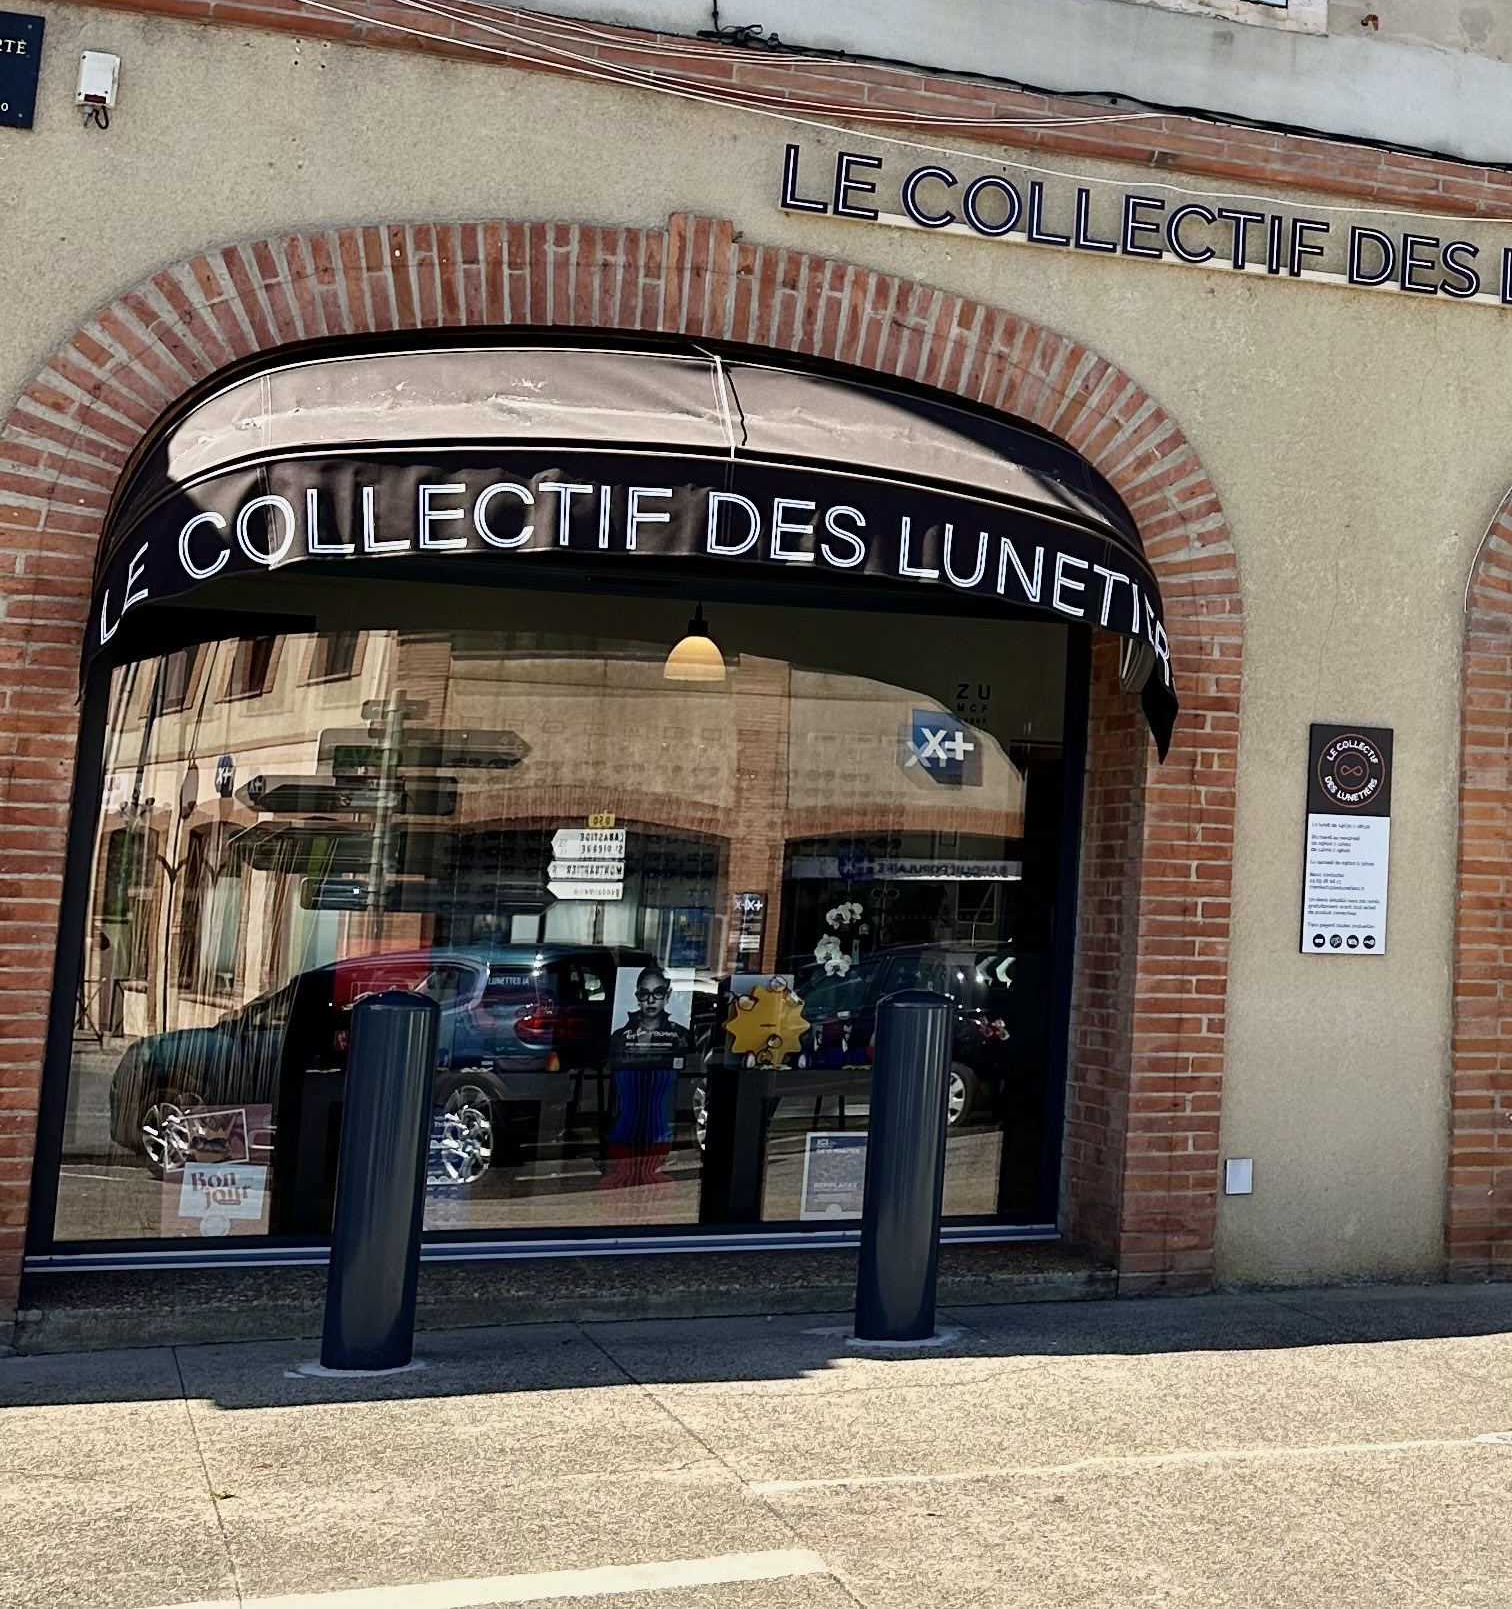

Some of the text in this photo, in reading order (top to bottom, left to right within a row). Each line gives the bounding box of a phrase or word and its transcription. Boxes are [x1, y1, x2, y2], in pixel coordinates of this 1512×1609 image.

[780, 143, 883, 221] LE
[901, 164, 1330, 278] COLLECTIF
[1347, 225, 1481, 299] DES
[100, 541, 150, 646] LE
[177, 482, 674, 580] COLLECTIF
[706, 491, 867, 569] DES
[1326, 739, 1379, 764] LE COLLECTIF
[1324, 775, 1378, 802] DES LUNETIERS
[191, 1172, 236, 1191] Bon
